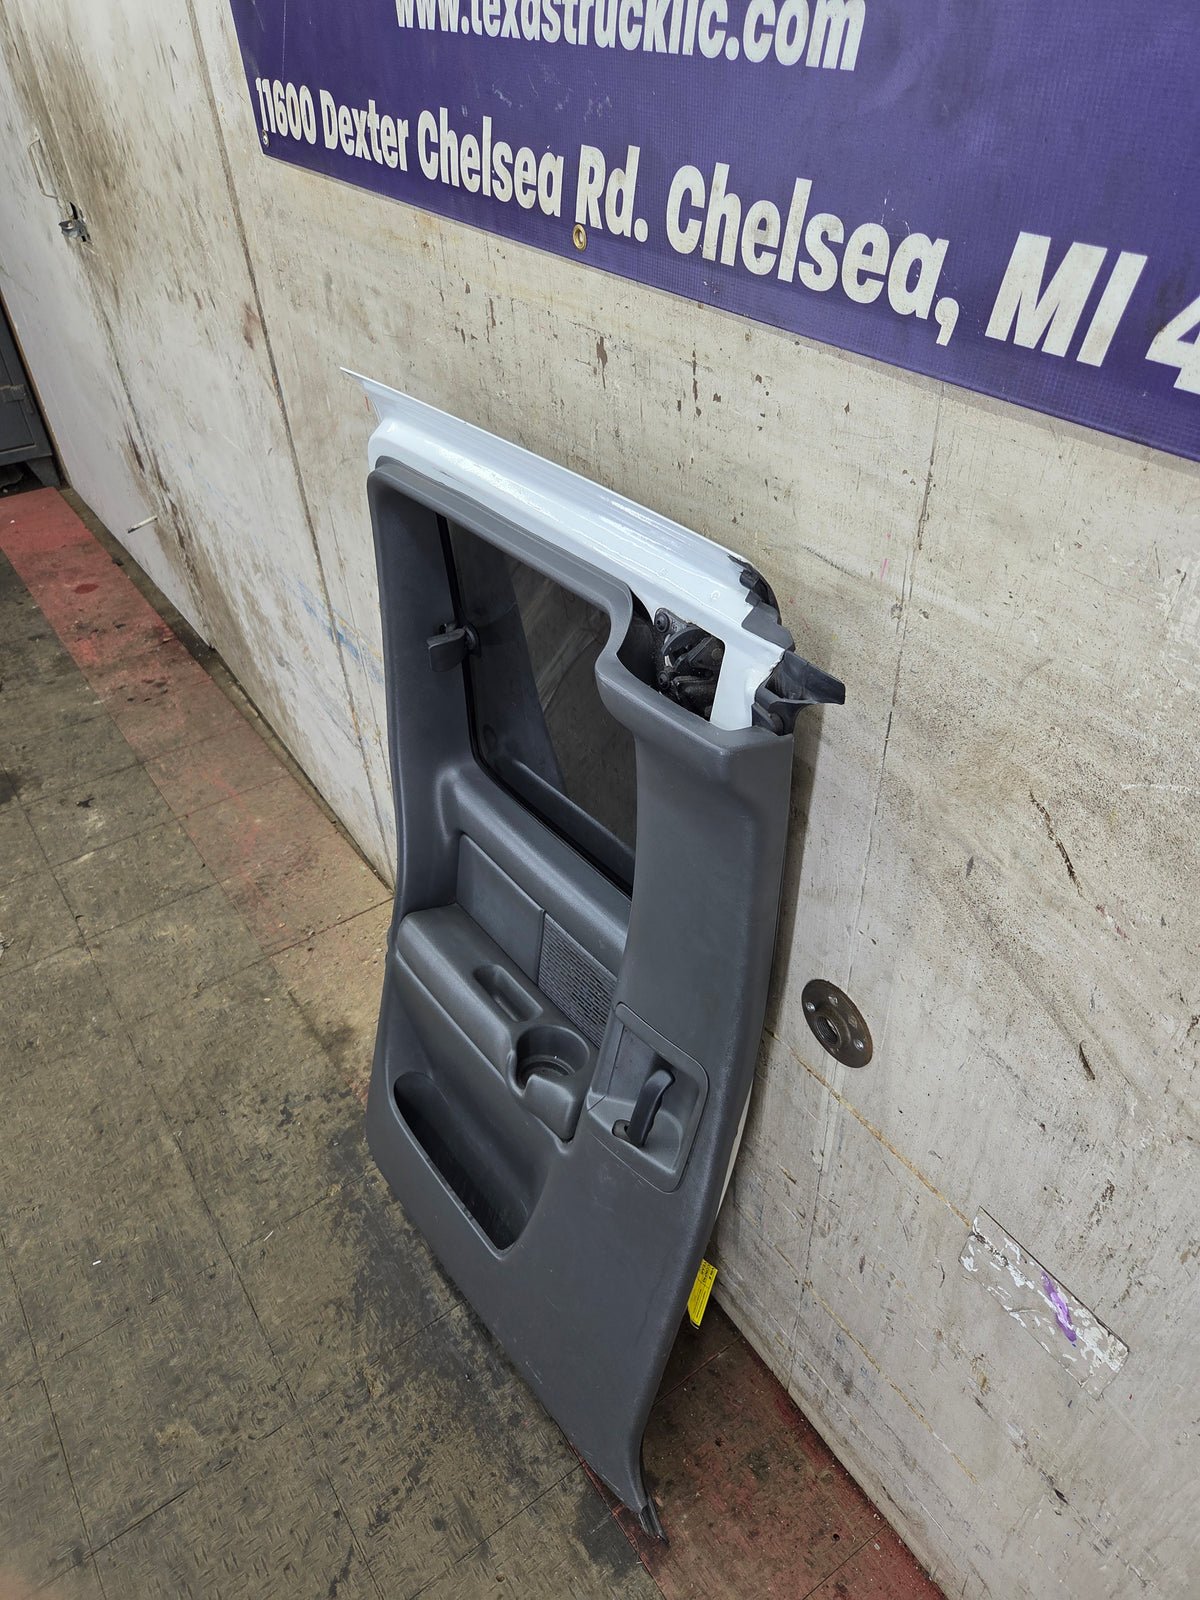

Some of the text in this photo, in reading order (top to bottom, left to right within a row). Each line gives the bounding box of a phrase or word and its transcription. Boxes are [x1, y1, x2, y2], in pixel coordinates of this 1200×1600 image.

[395, 0, 867, 72] www.texastruckllc.com
[255, 77, 317, 145] 11600
[319, 88, 409, 172] Dexter
[417, 106, 565, 218] Chelsea
[574, 143, 649, 244] Rd.
[665, 161, 960, 347] Chelsea,
[984, 230, 1148, 367] MI
